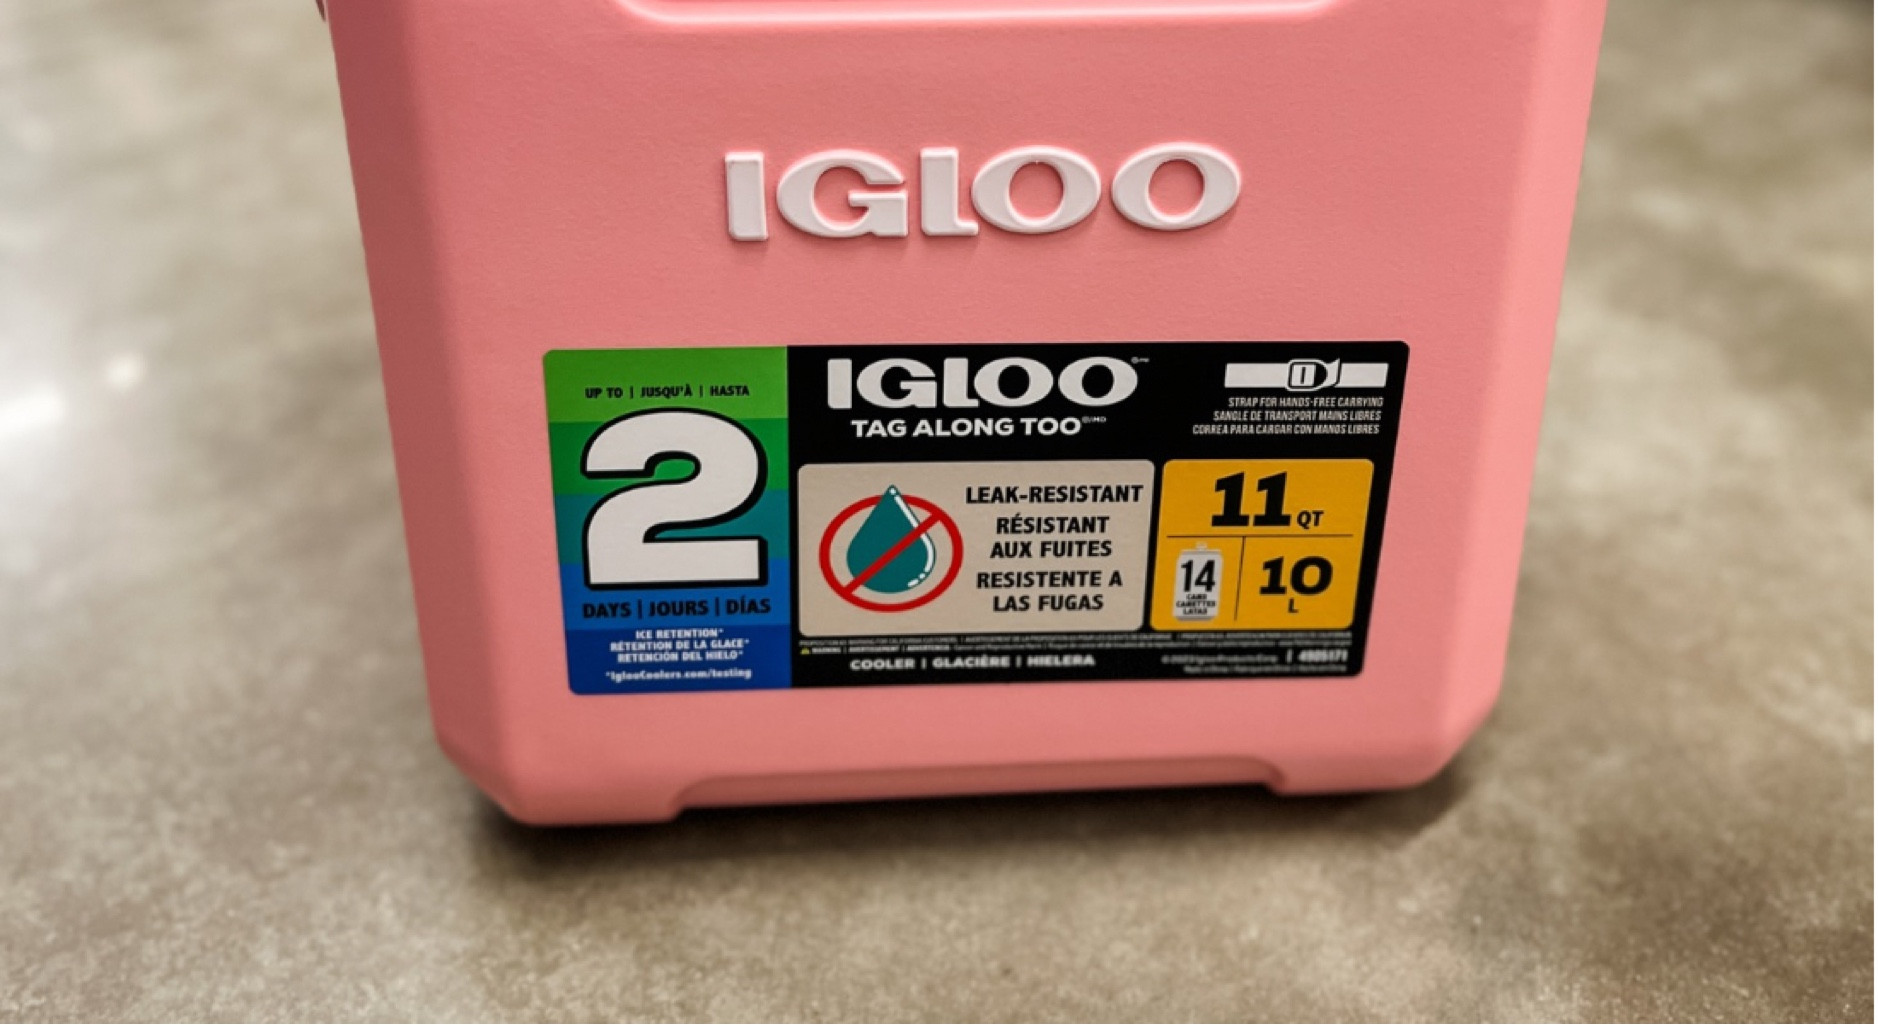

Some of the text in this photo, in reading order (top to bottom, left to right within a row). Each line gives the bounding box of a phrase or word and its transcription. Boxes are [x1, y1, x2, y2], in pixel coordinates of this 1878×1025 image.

[724, 141, 1242, 241] IGLOO
[585, 383, 750, 399] UP TO JUSQU'À HASTA
[827, 356, 1138, 409] IGLOO
[1228, 397, 1384, 408] STRAP FOR HANDS-FREE CARRYING
[1213, 410, 1381, 422] SANGLE DE TRANSPORT MAINS LIBRES
[851, 419, 907, 437] TAG
[912, 418, 1015, 437] ALONG
[1192, 424, 1380, 435] CORREA PARA CARGAR CON MANOS LIBRES
[580, 407, 769, 591] 2
[965, 484, 1144, 504] LEAK-RESISTANT
[1211, 471, 1325, 529] 11 QT
[996, 512, 1110, 534] RÉSISTANT
[990, 540, 1112, 558] AUX FUITES
[976, 570, 1123, 589] RESISTENTE A
[1181, 559, 1215, 592] 14
[1259, 556, 1334, 596] 10
[582, 595, 771, 618] DAYS JOURS DÍAS
[993, 594, 1104, 612] LAS FUGAS
[1288, 598, 1299, 613] L
[635, 629, 653, 640] ICE
[610, 639, 673, 652] RÉTENTION
[675, 640, 690, 650] DE
[694, 640, 707, 650] LA
[617, 650, 679, 664] RETENCIÓN
[682, 652, 703, 661] DEL
[851, 654, 1096, 671] COOLER GLACIÈRE HIELERA
